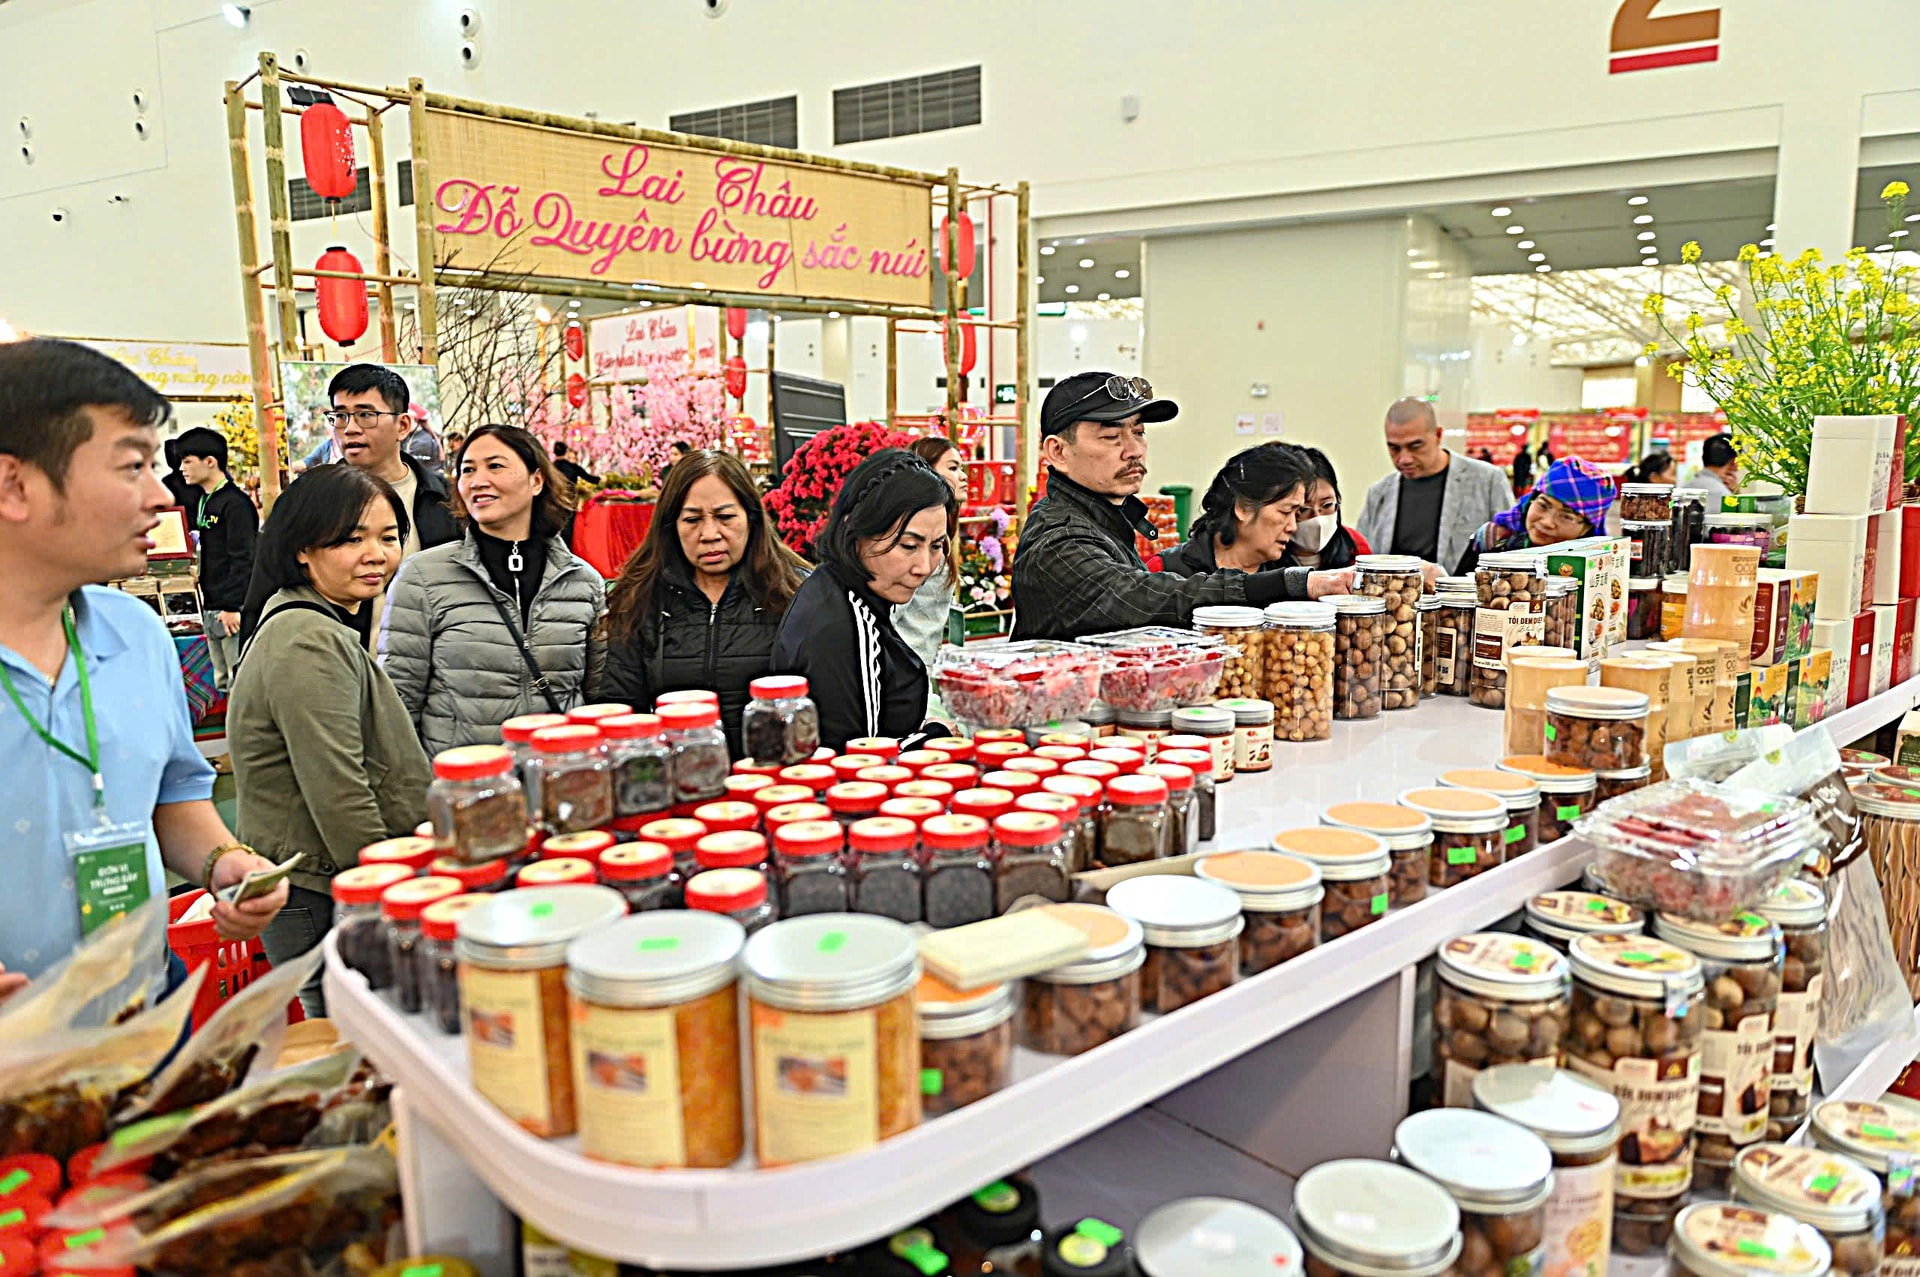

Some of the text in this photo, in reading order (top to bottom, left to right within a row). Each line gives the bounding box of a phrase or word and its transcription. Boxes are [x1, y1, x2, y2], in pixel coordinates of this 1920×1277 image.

[598, 144, 818, 220] Lai Châu
[436, 179, 928, 289] Đỗ Quyên bừng sắc núi
